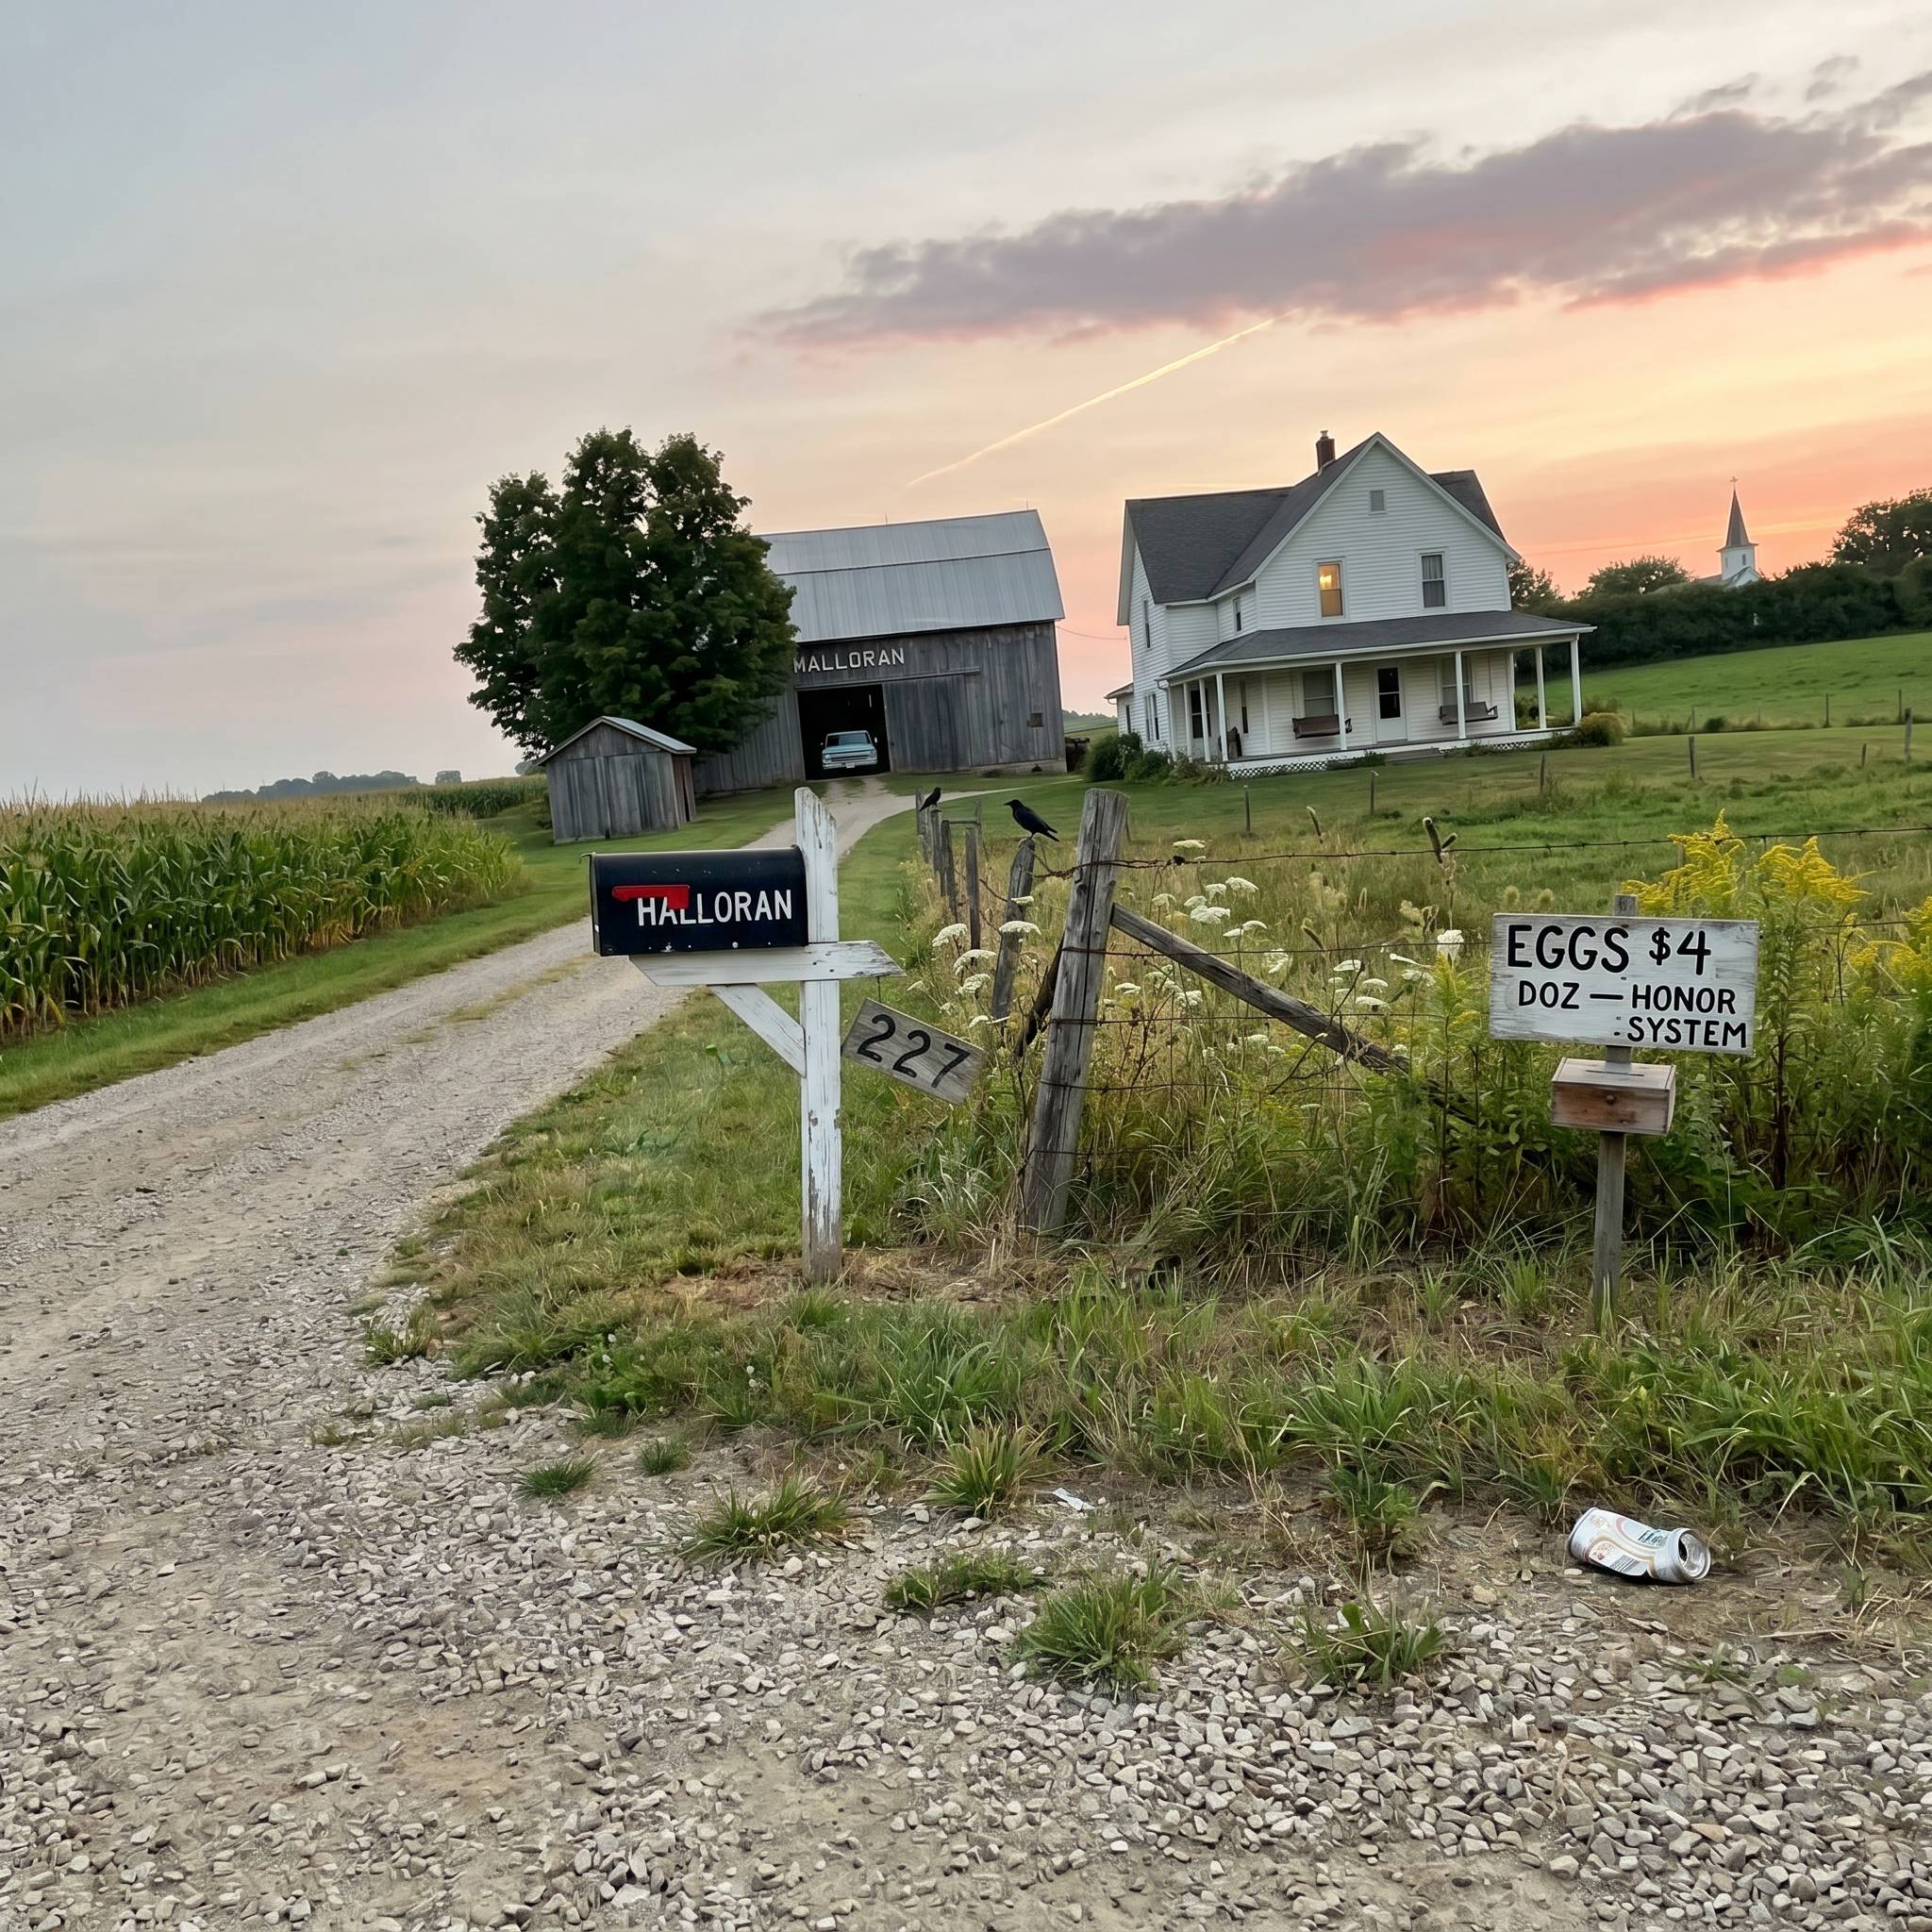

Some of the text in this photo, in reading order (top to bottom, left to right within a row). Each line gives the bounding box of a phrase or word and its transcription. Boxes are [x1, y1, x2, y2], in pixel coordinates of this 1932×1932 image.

[793, 647, 905, 674] MALLORAN
[1507, 924, 1711, 975] EGGS $4
[1518, 980, 1580, 1009] DOZ
[1632, 984, 1736, 1015] HONOR
[1627, 1016, 1746, 1049] SYSTEM
[857, 1014, 972, 1089] 227
